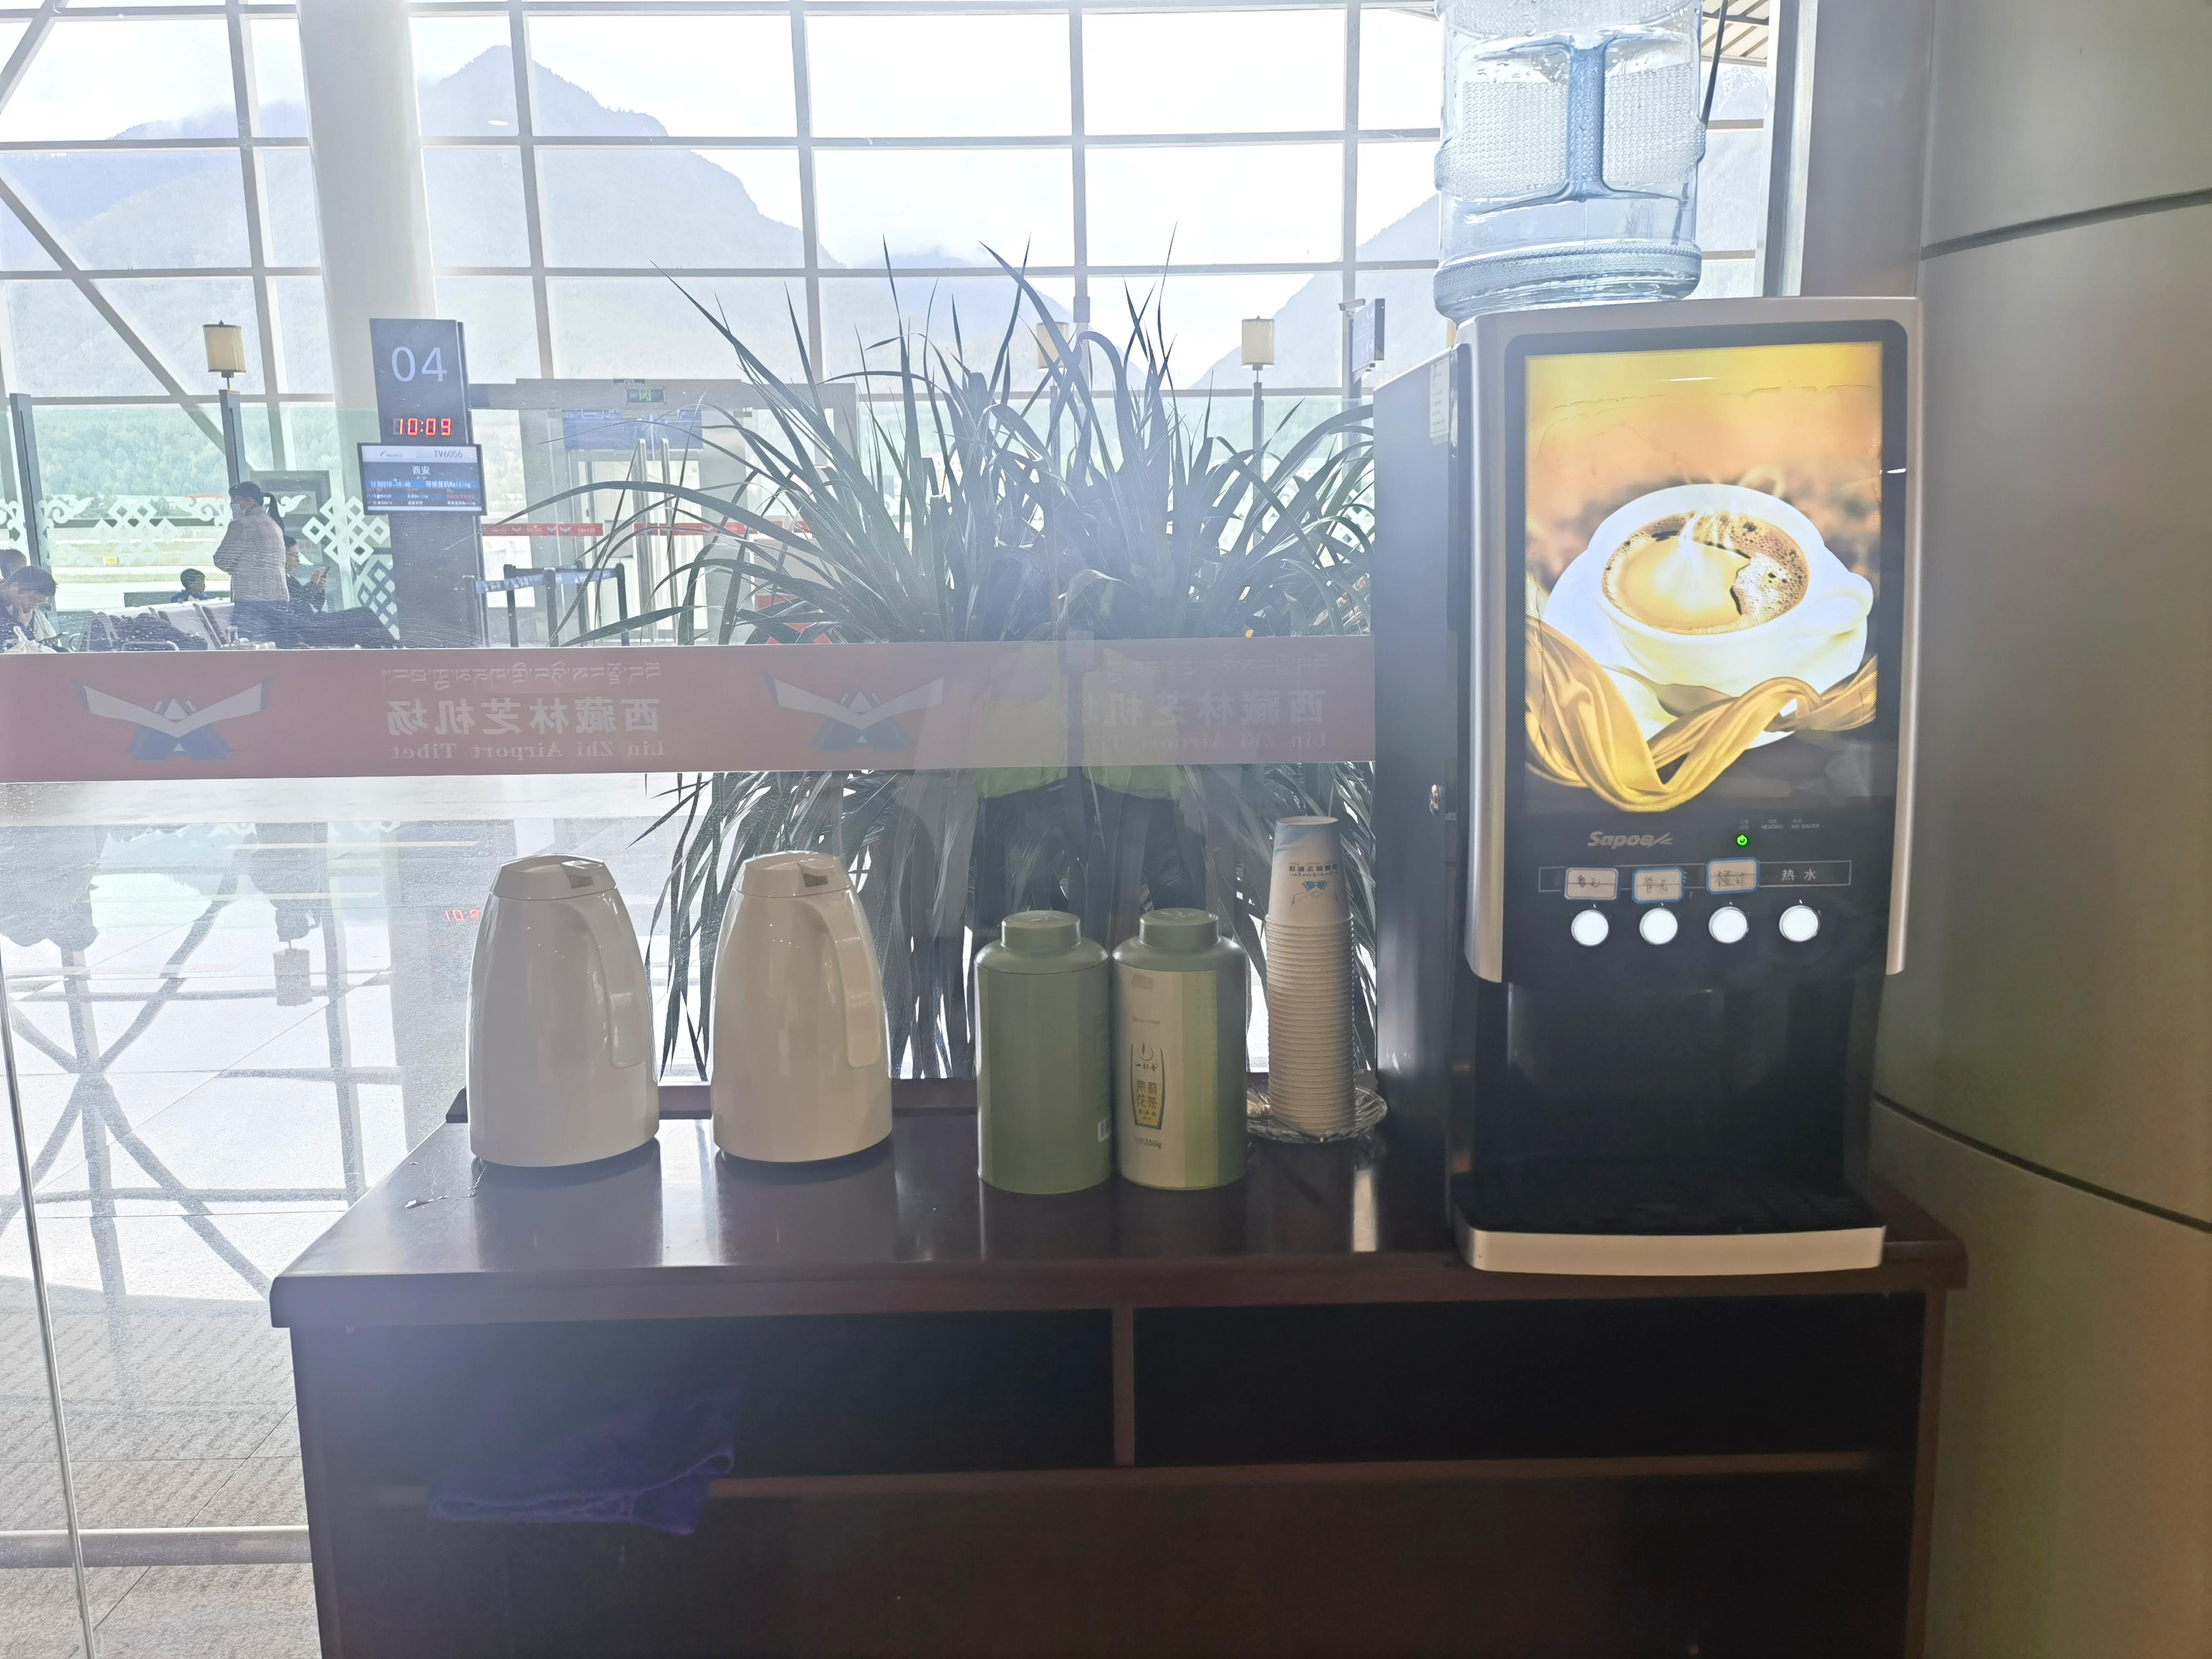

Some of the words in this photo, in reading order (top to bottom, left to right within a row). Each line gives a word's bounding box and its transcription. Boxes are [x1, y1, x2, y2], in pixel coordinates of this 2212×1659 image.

[391, 346, 447, 382] 04
[399, 417, 451, 436] 10:09
[434, 450, 463, 458] TV6056
[412, 465, 430, 475] 西安
[1587, 831, 1663, 849] Sapoe
[1781, 868, 1816, 882] 热水
